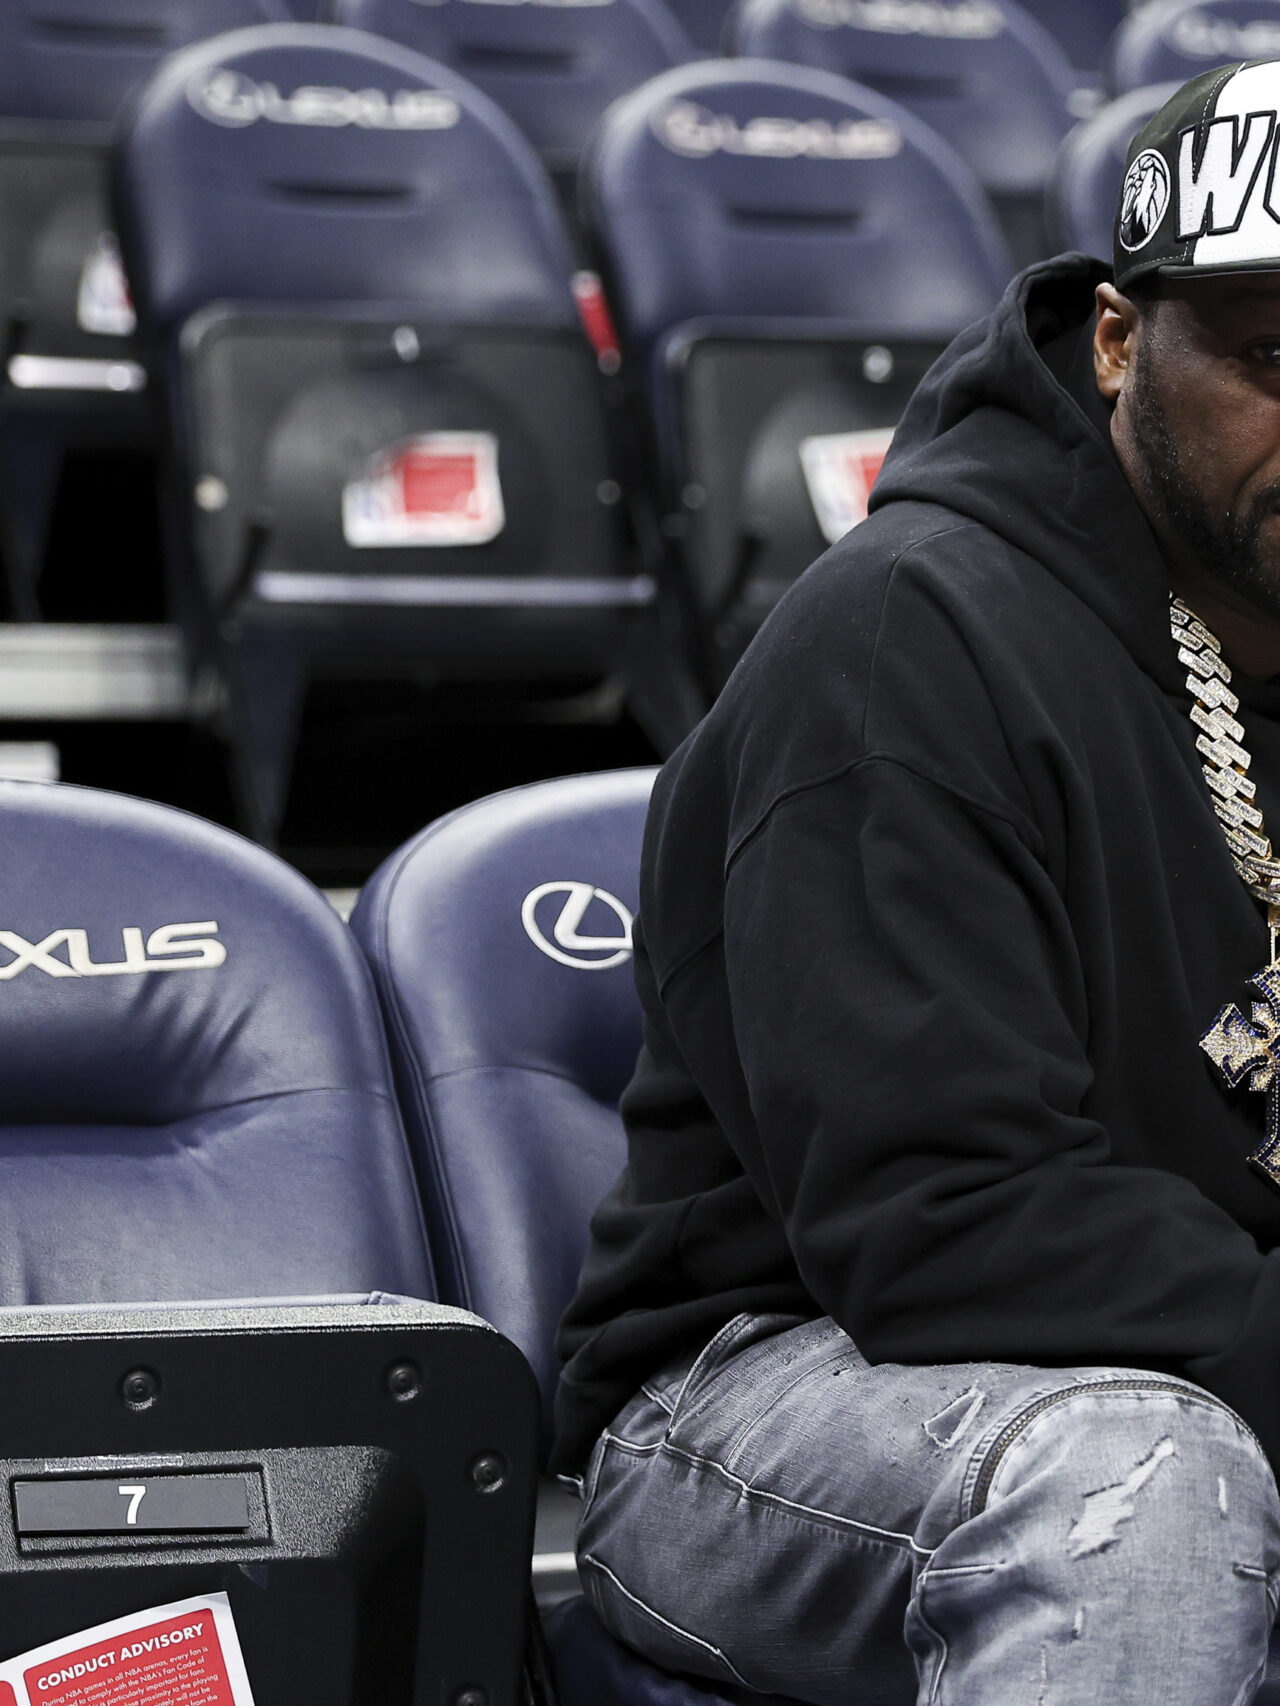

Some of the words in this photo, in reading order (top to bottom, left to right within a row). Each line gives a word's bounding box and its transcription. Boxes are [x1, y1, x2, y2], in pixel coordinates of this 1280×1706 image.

[0, 920, 227, 980] XUS
[118, 1485, 146, 1524] 7
[37, 1651, 116, 1690] CONDUCT
[120, 1622, 204, 1661] ADVISORY
[65, 1688, 83, 1699] NBA
[83, 1681, 106, 1694] games
[114, 1672, 124, 1681] all
[124, 1667, 142, 1678] NBA
[169, 1653, 189, 1663] every
[189, 1648, 202, 1656] fan
[87, 1688, 112, 1702] comply
[113, 1681, 128, 1692] with
[127, 1679, 139, 1687] the
[139, 1671, 162, 1683] NBA's
[162, 1667, 176, 1676] Fan
[176, 1660, 197, 1671] Code
[197, 1655, 205, 1665] of
[106, 1687, 145, 1706] particularly
[145, 1676, 178, 1692] important
[178, 1672, 189, 1681] for
[189, 1668, 205, 1677] fans
[140, 1688, 172, 1705] proximity
[192, 1674, 219, 1688] playing
[175, 1692, 188, 1703] will
[189, 1689, 200, 1697] not
[201, 1686, 211, 1694] be
[206, 1694, 218, 1702] the
